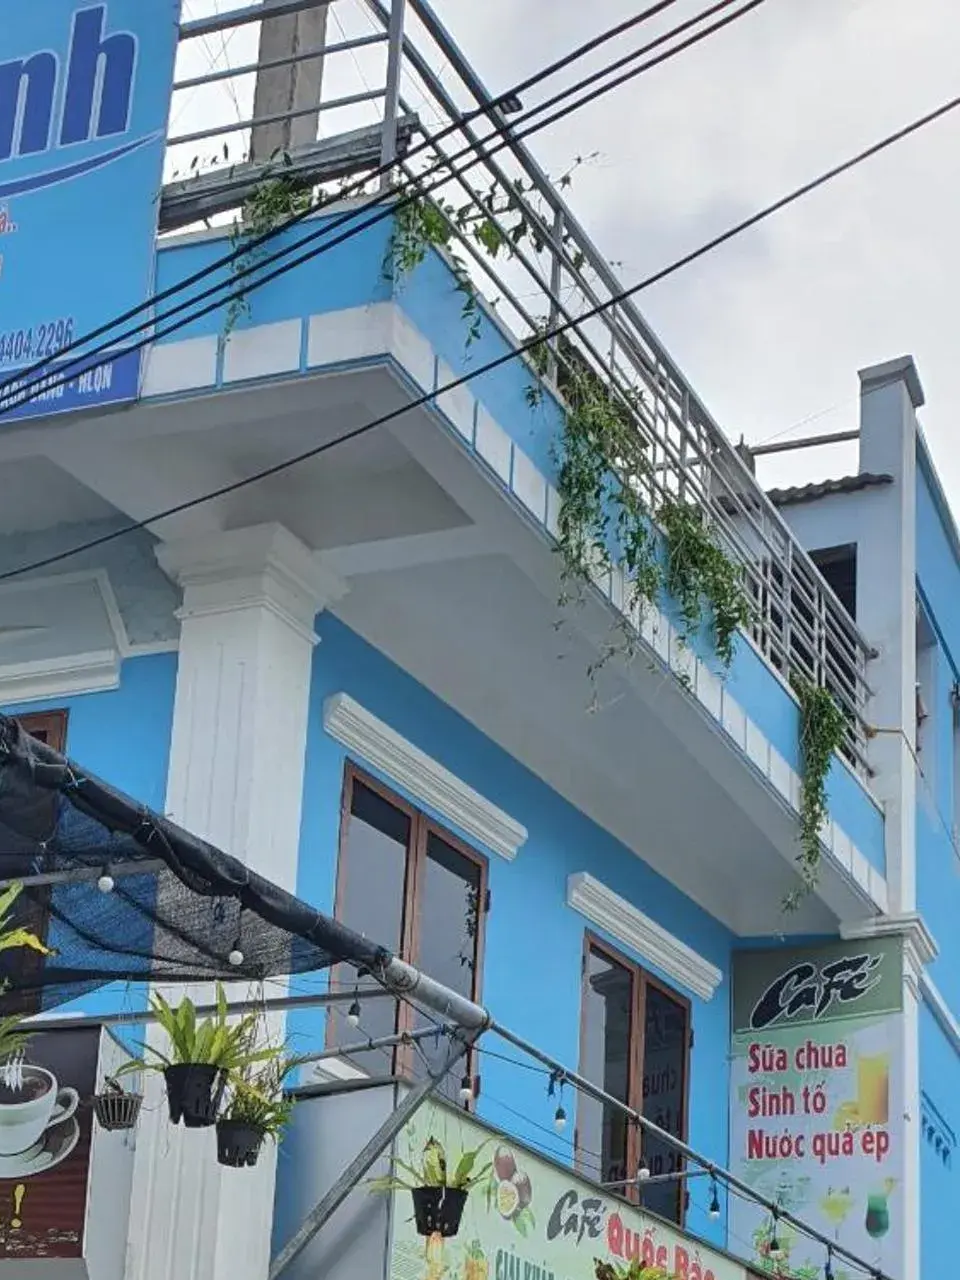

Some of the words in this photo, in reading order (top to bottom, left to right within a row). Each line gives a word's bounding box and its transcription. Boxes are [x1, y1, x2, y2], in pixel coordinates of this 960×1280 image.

[747, 1043, 788, 1074] Sữa
[795, 1041, 848, 1071] chua
[747, 1086, 796, 1117] Sinh
[802, 1080, 827, 1115] tố
[747, 1129, 805, 1161] Nước
[812, 1125, 855, 1164] quả
[860, 1125, 890, 1163] ép
[606, 1212, 668, 1272] Quốc
